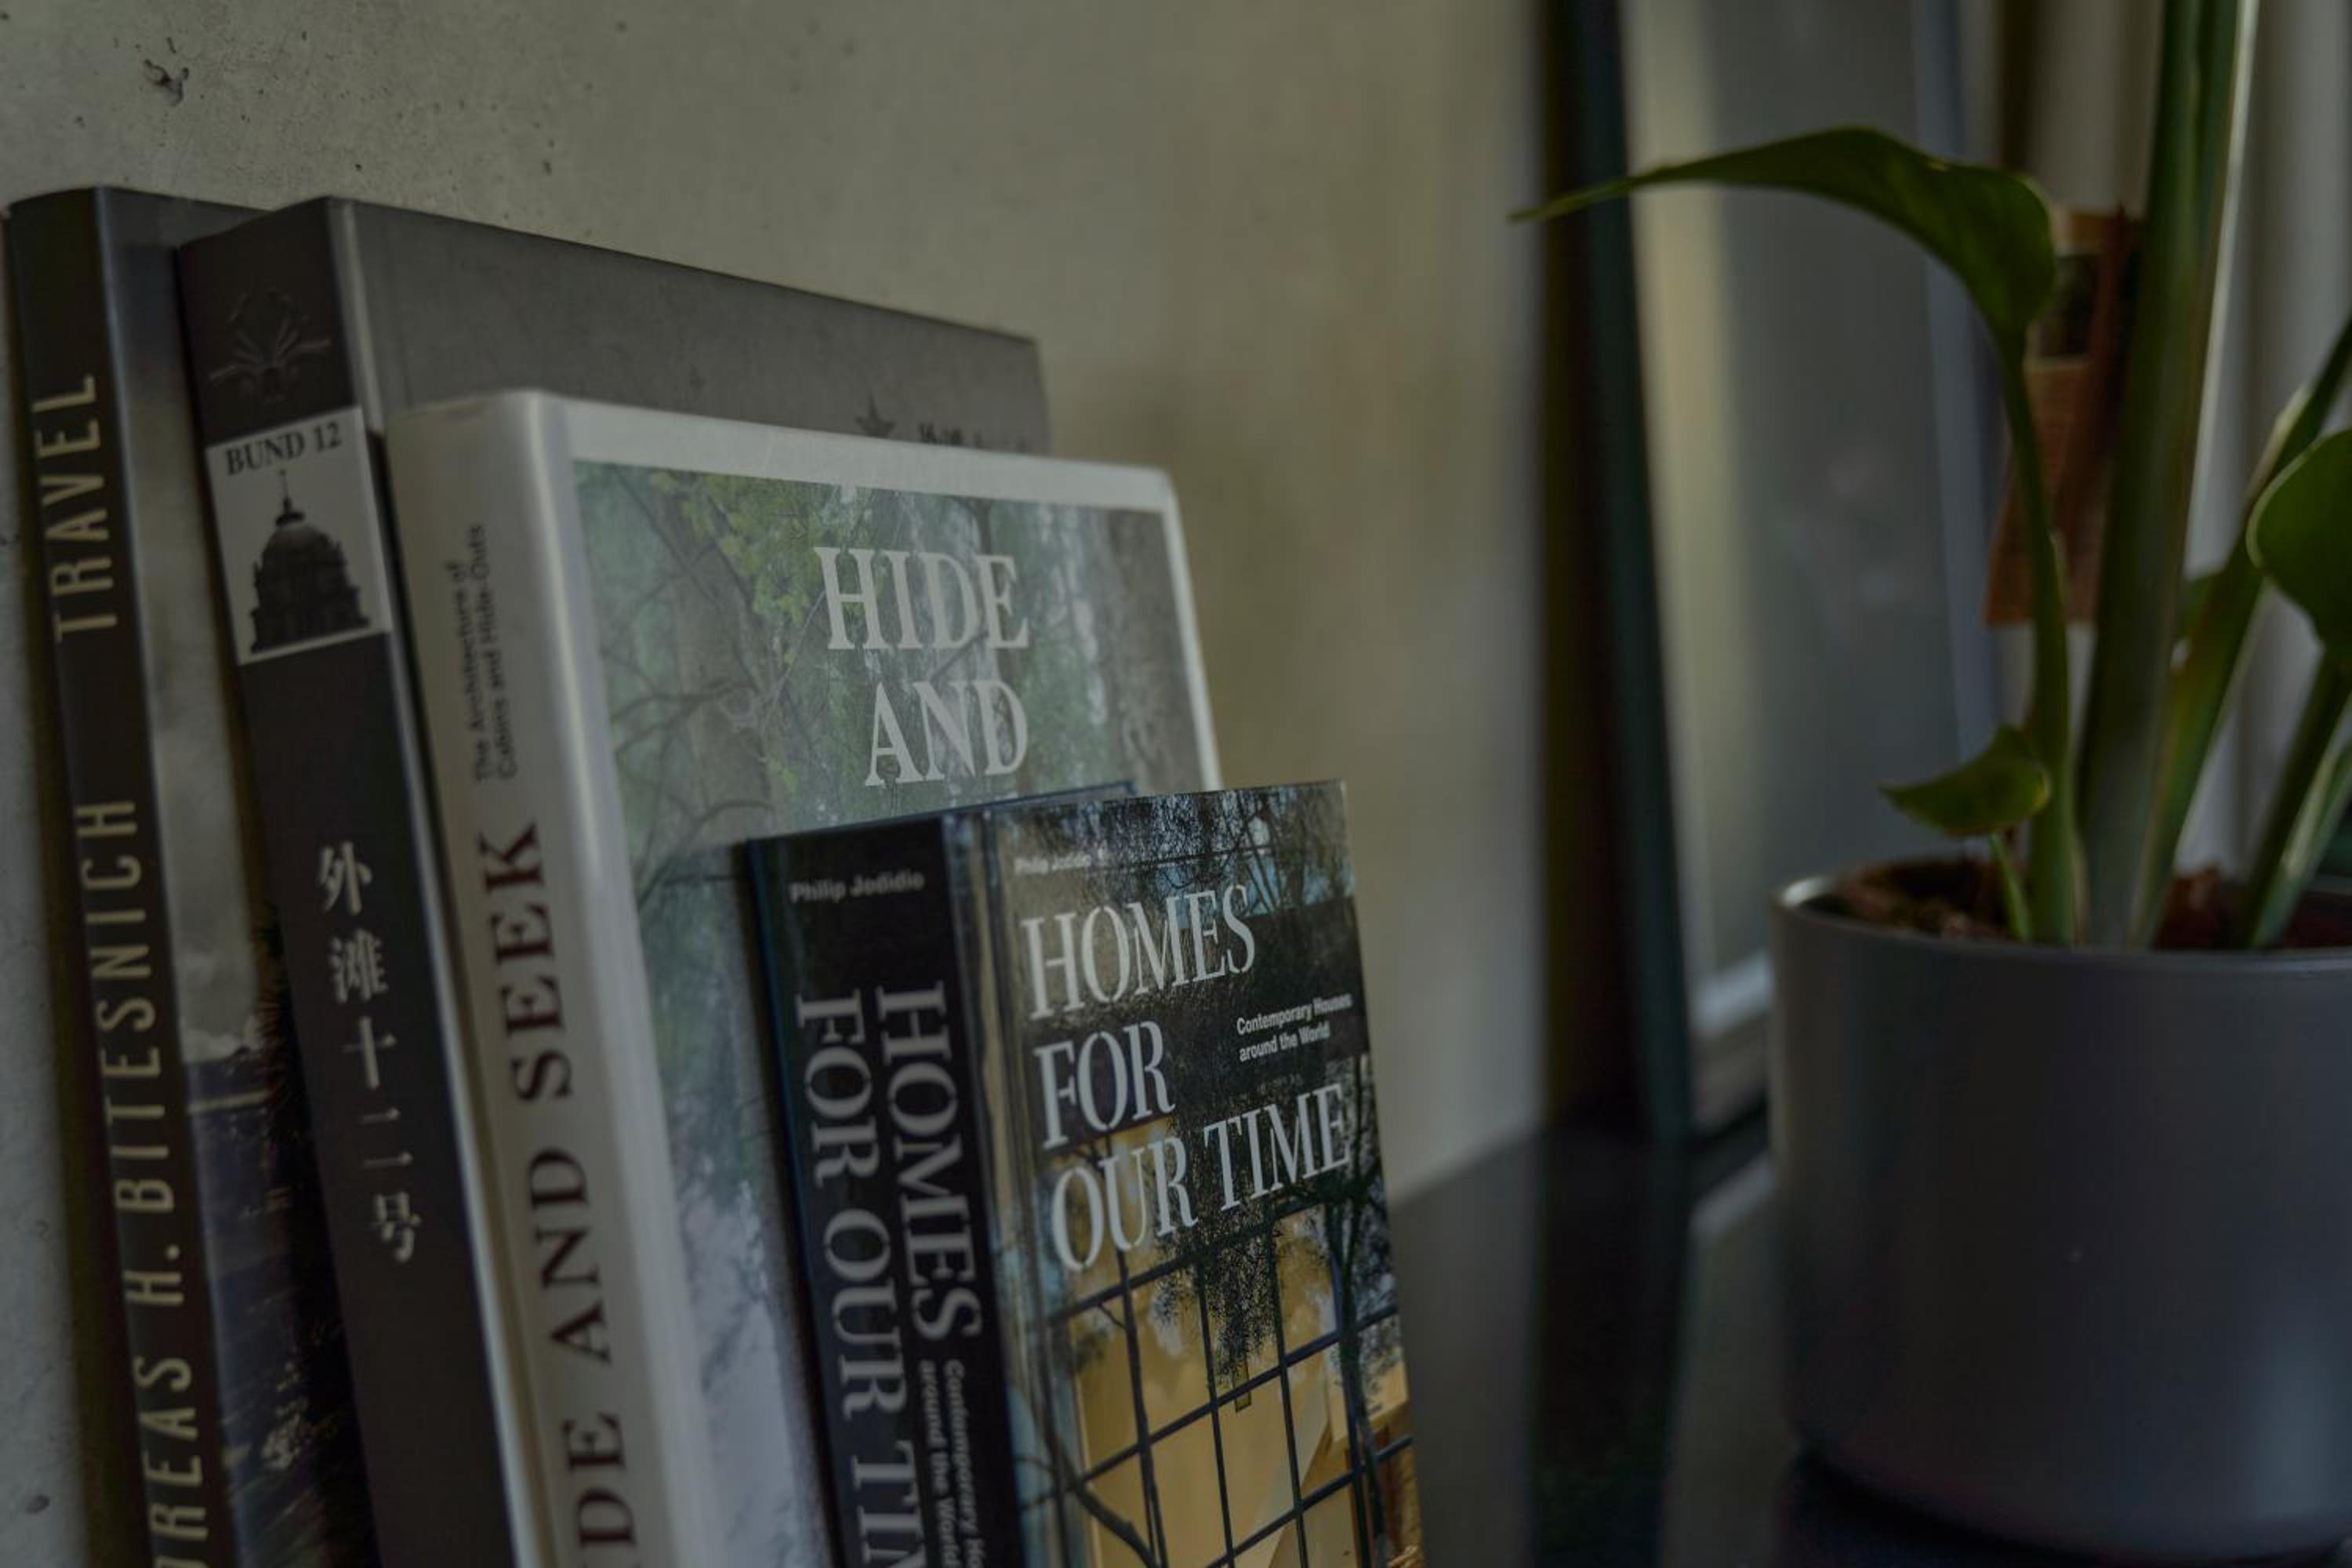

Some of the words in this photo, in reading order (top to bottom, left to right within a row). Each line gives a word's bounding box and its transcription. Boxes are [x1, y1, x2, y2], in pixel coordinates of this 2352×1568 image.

[31, 373, 118, 643] TRAVEL
[227, 432, 305, 476] BUND
[314, 422, 342, 452] 12
[814, 546, 1029, 650] HIDE
[482, 649, 506, 690] and
[865, 680, 1029, 786] AND
[476, 739, 491, 780] The
[494, 699, 518, 779] Cabins
[790, 878, 847, 904] Philip
[849, 868, 926, 898] Jodidio
[74, 799, 176, 1218] BITESNICH
[478, 823, 572, 1105] SEEK
[1021, 884, 1256, 1019] HOMES
[316, 840, 423, 1263] 外滩十二号
[1236, 1003, 1314, 1035] Contemporary
[1239, 1034, 1278, 1062] around
[1278, 1032, 1299, 1051] the
[1298, 1020, 1330, 1045] World
[795, 988, 880, 1189] FOR
[1034, 1021, 1175, 1150] FOR
[875, 980, 983, 1344] HOMES
[1051, 1137, 1199, 1273] OUR
[1203, 1083, 1352, 1212] TIME
[123, 1243, 184, 1308] H.
[528, 1145, 612, 1364] AND
[822, 1209, 909, 1422] OUR
[918, 1358, 949, 1450] around
[942, 1358, 979, 1535] Contemporary
[561, 1412, 643, 1568] DE
[929, 1450, 951, 1496] the
